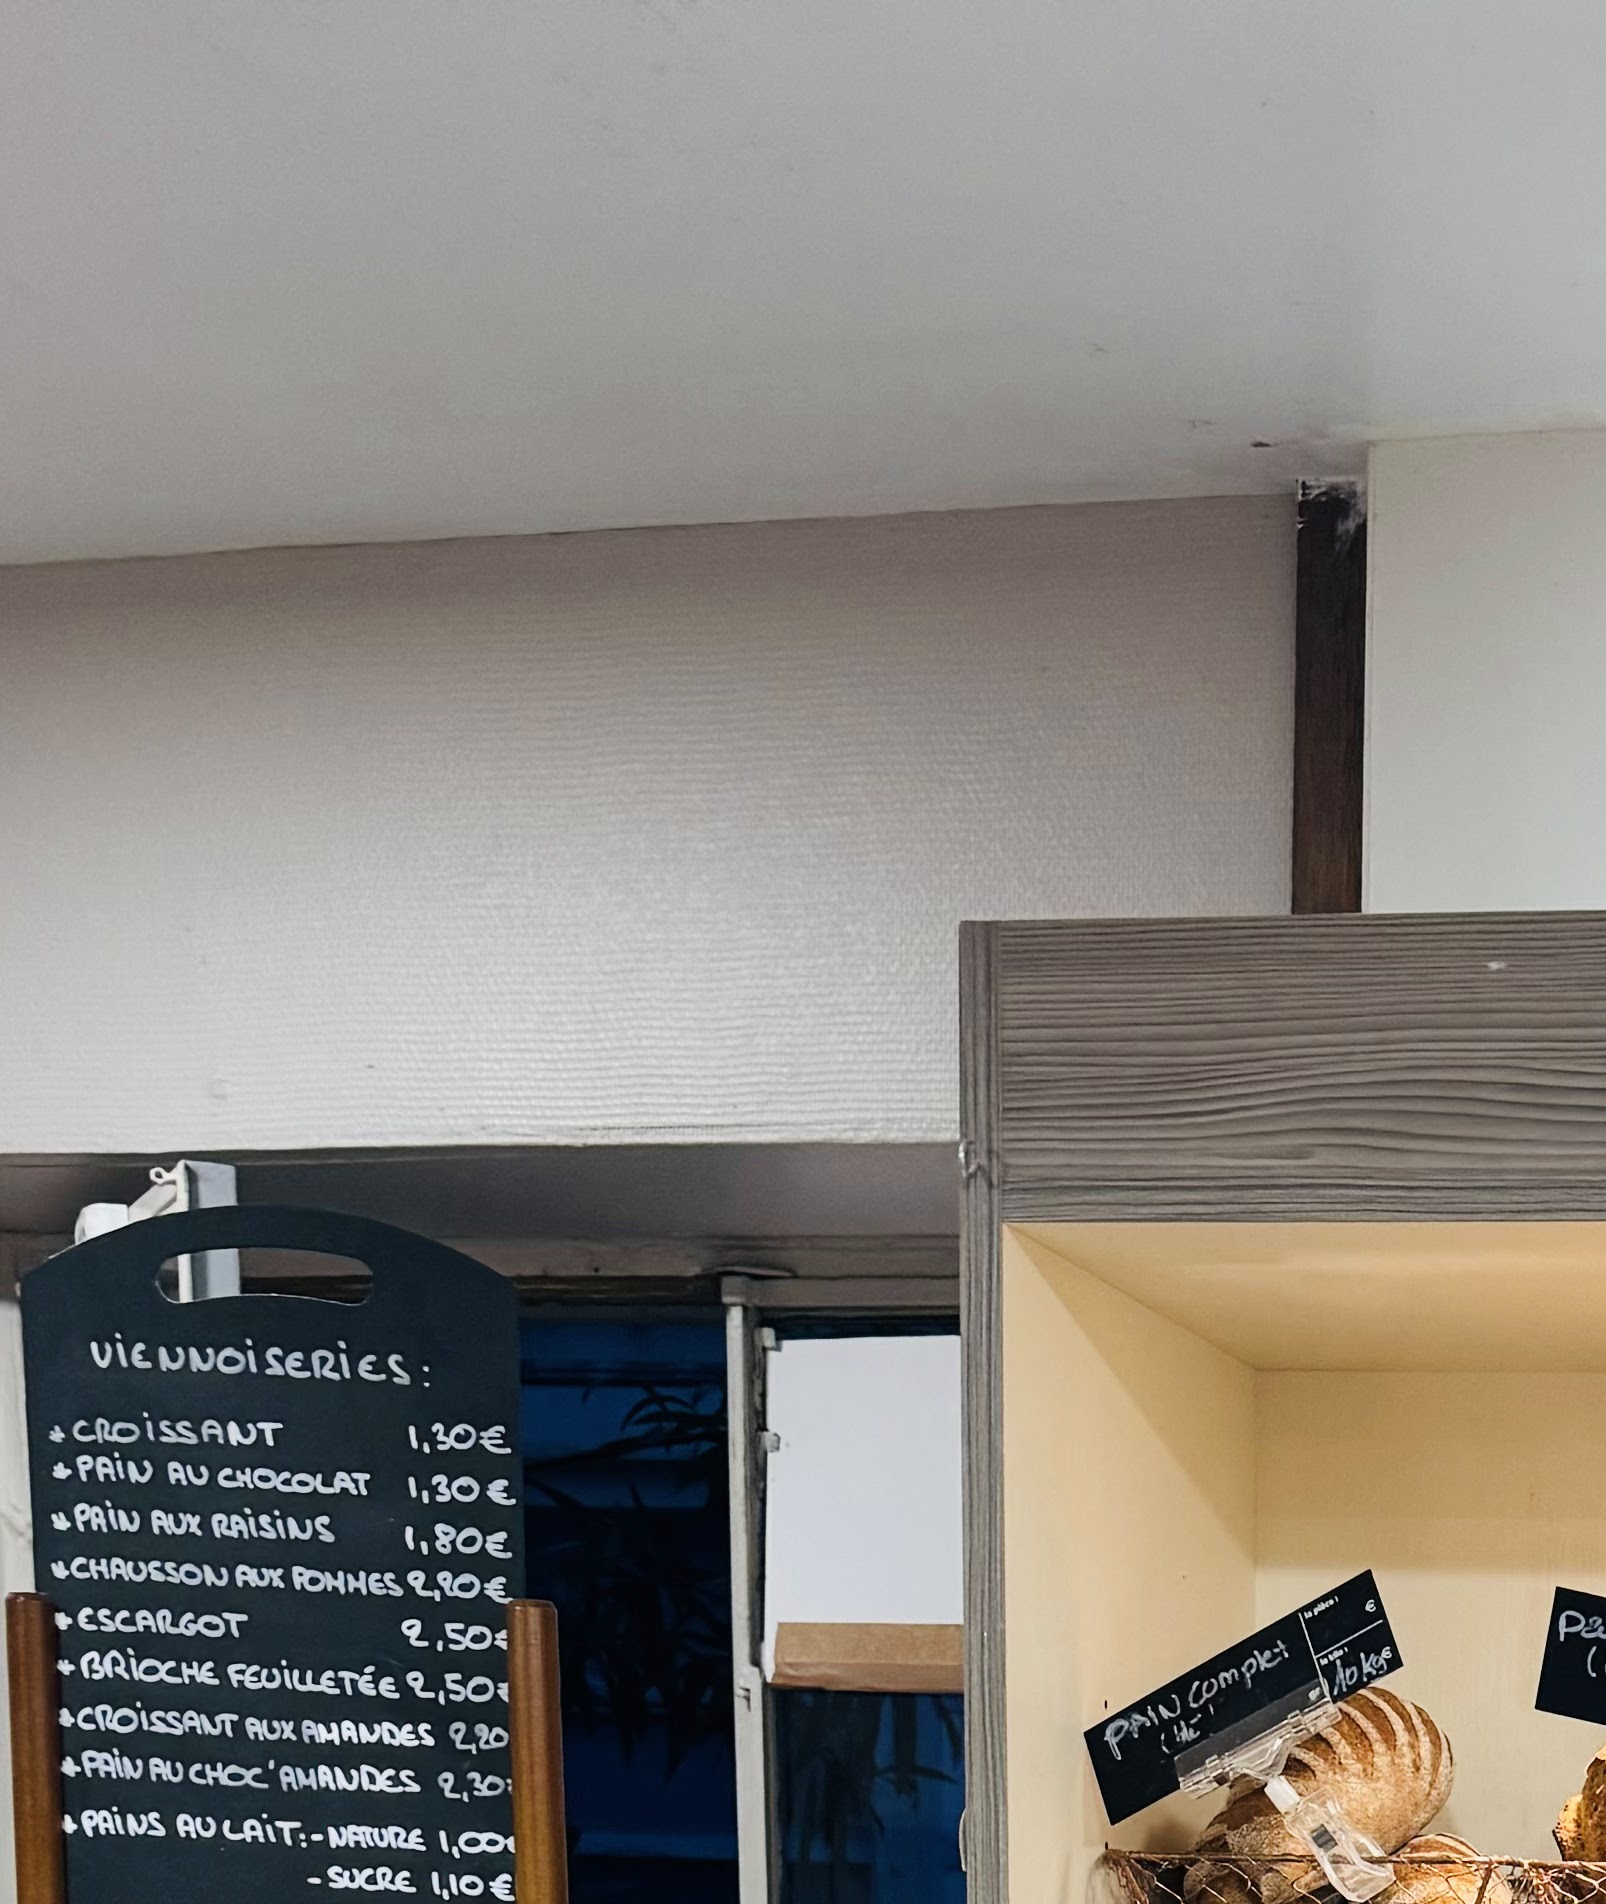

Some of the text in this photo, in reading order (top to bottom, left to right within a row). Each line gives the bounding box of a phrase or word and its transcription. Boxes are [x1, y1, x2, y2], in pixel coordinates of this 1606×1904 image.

[72, 1412, 512, 1455] CROISSANT 1,30€
[75, 1452, 517, 1506] PAIN AU CHOCOLAT 1,30€
[75, 1500, 513, 1559] PAIN AUX RAISINS 1,80€
[70, 1554, 513, 1605] CHAUSSON AUX POMMES 2,20€
[77, 1607, 249, 1639] ESCARGOT
[80, 1647, 220, 1686] BRIOCHE
[227, 1659, 401, 1700] FEUILLETÉE
[76, 1701, 240, 1736] CROISSANT
[246, 1717, 297, 1742] AUX
[301, 1720, 436, 1748] AMANDES
[1104, 1693, 1181, 1761] PAIN
[81, 1747, 144, 1780] PAIN
[149, 1757, 184, 1783] AU
[437, 1771, 512, 1803] 2,30
[81, 1805, 167, 1838] PAINS
[176, 1816, 217, 1842] AU
[431, 1870, 516, 1902] 1,10€
